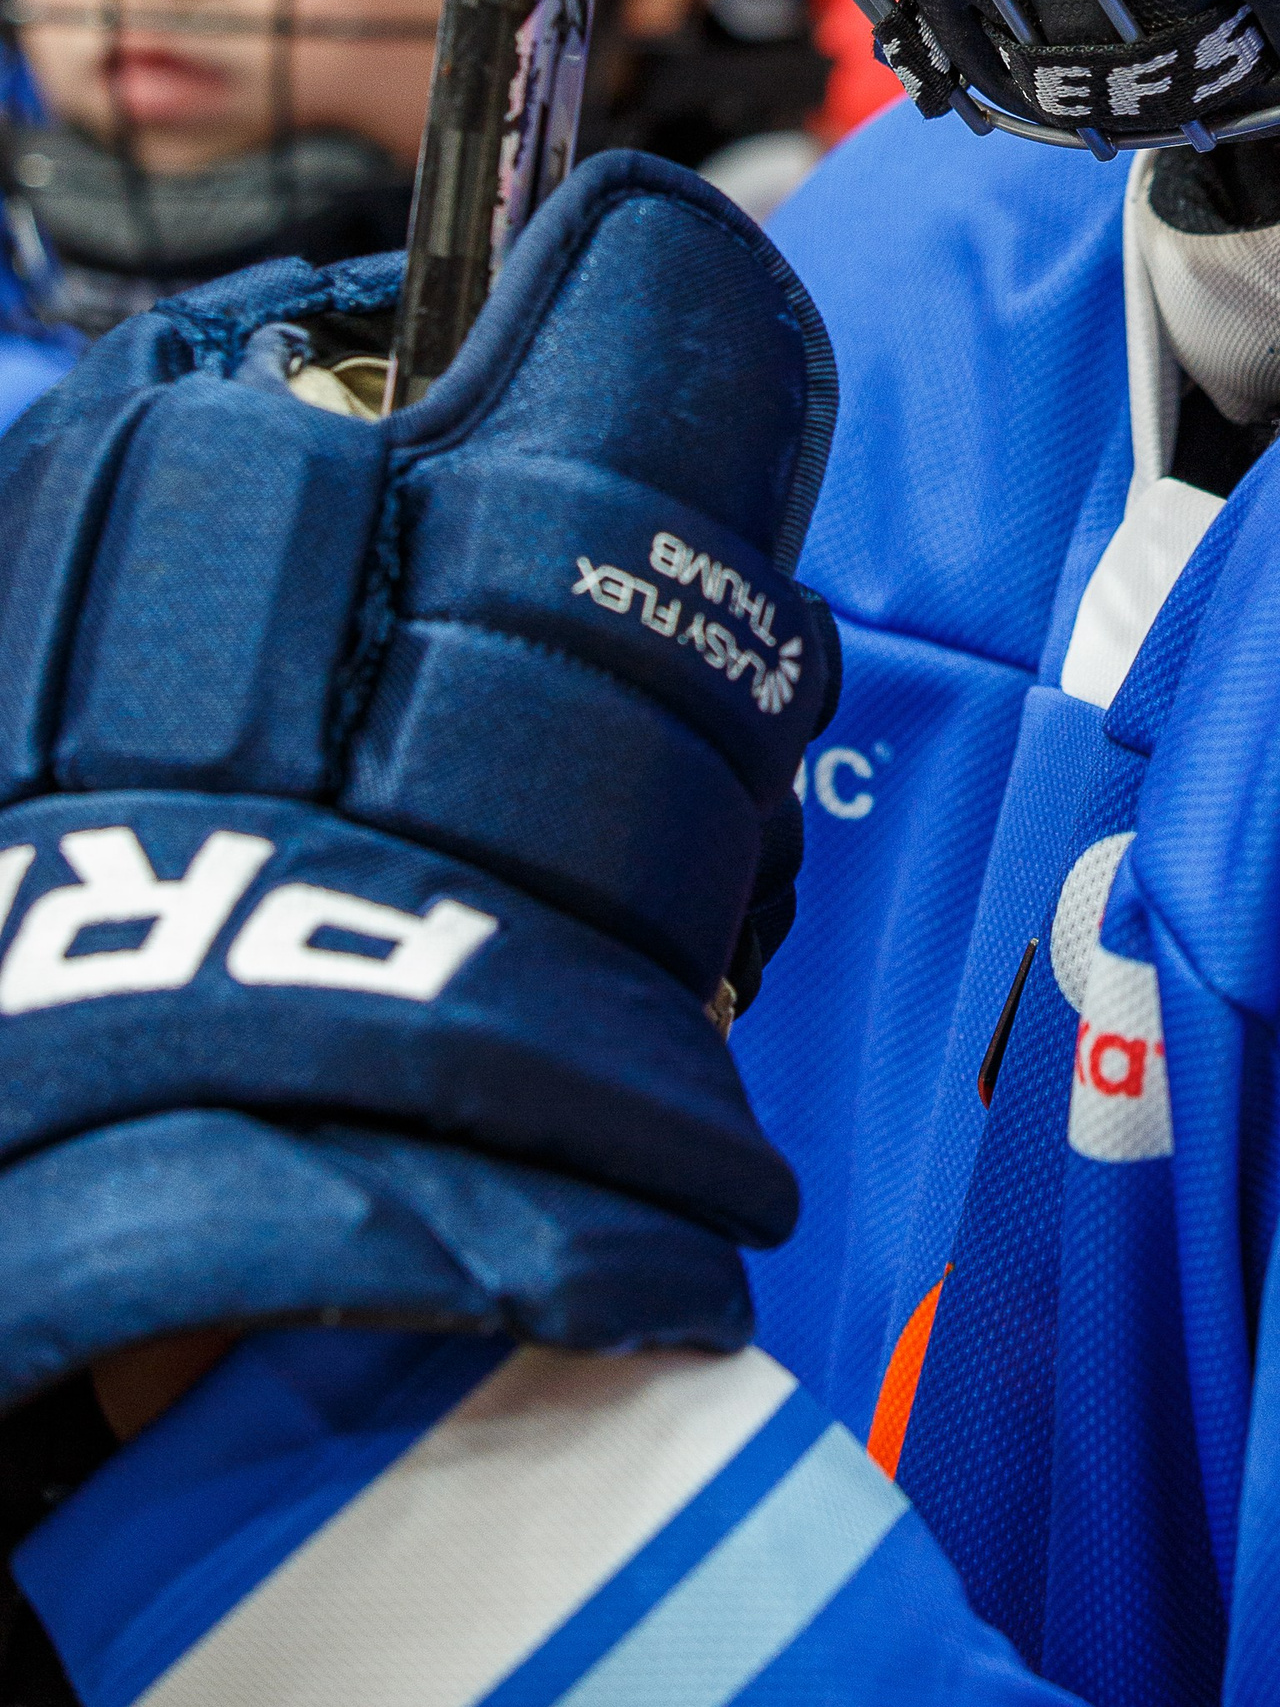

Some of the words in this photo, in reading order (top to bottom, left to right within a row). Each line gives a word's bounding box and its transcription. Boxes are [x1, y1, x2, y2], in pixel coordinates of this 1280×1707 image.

[571, 555, 683, 639] FLEX
[649, 531, 777, 647] THUMB
[0, 826, 498, 1015] PR
